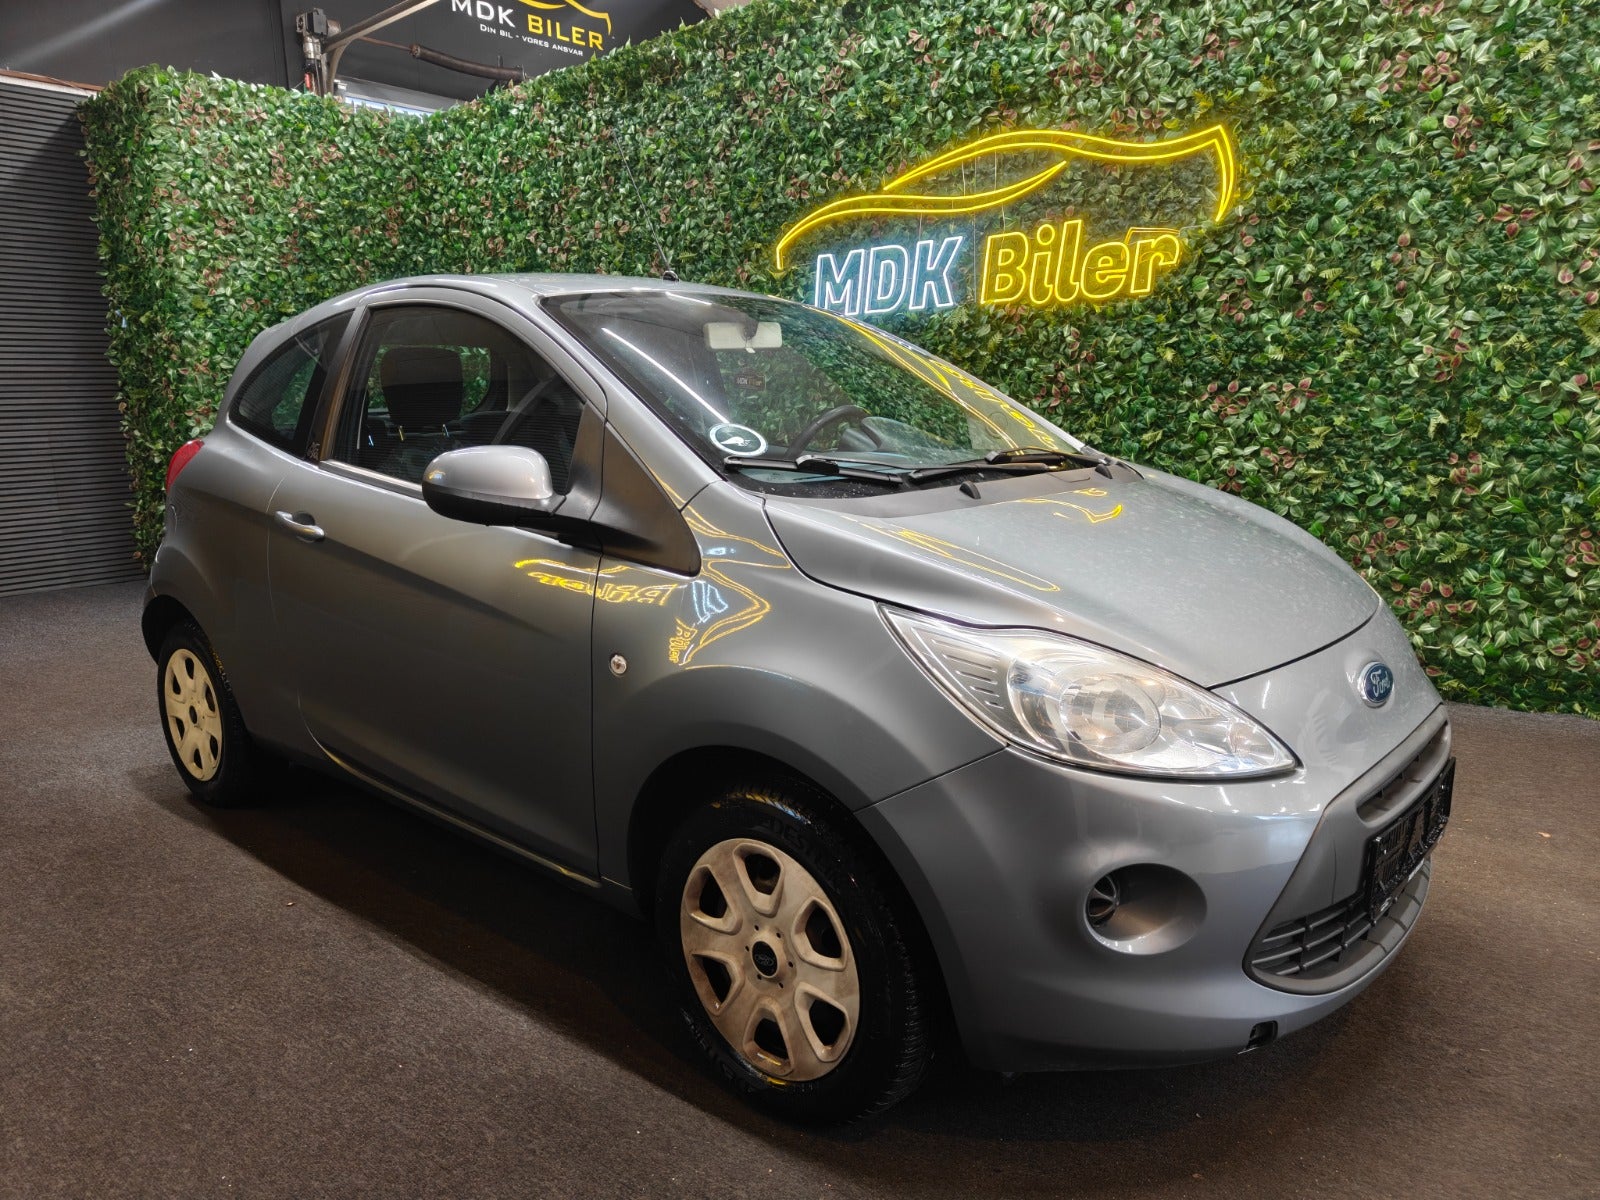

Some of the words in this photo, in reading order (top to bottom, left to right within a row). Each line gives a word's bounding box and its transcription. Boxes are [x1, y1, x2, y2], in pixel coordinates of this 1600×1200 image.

[451, 0, 516, 28] MDK
[527, 13, 604, 51] BILER
[521, 35, 550, 48] VORES
[552, 43, 584, 56] ANSVAR
[814, 235, 964, 316] MDK
[980, 219, 1181, 305] Biler
